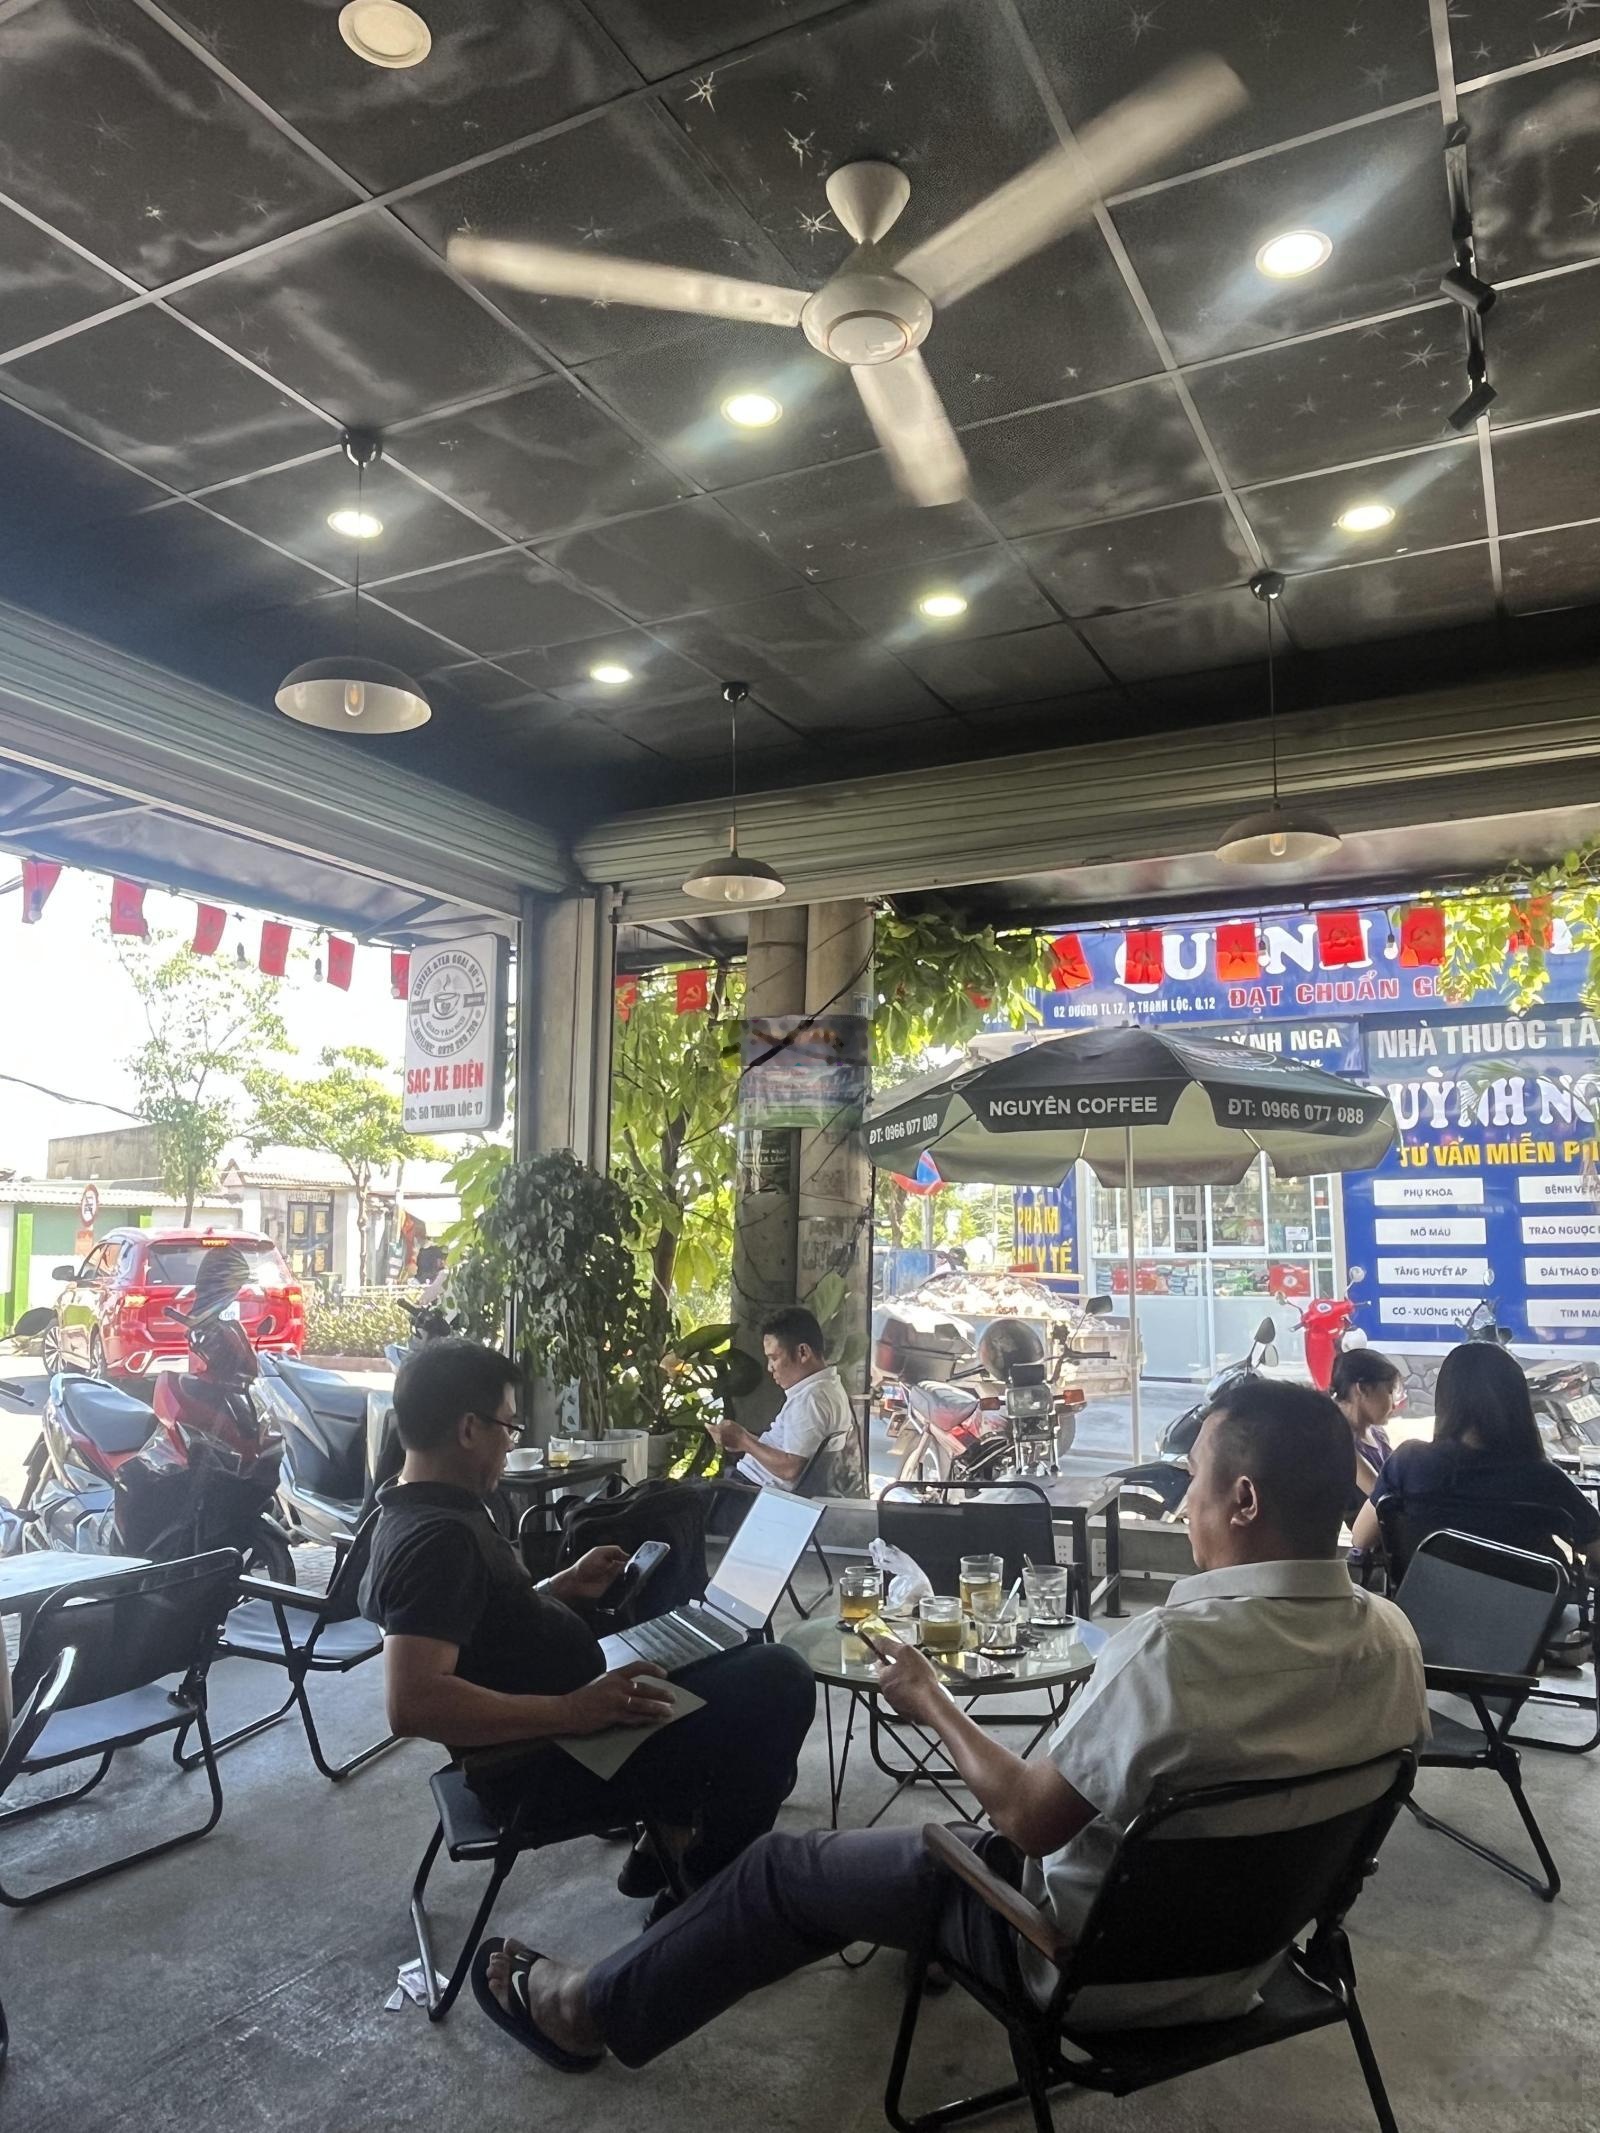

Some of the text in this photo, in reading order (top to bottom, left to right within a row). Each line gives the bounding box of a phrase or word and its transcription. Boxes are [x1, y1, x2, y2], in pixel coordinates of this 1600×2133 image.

[1228, 984, 1283, 1014] ĐẠT
[1295, 970, 1400, 1004] CHUẨN
[1101, 1003, 1111, 1015] TL
[1290, 1028, 1343, 1050] NGA
[1377, 1019, 1438, 1058] NHÀ
[1442, 1015, 1547, 1055] THUỐC
[407, 1059, 484, 1098] SẠC XE ĐIỆN
[475, 1101, 483, 1116] 17
[989, 1095, 1158, 1117] NGUYÊN COFFEE
[1228, 1099, 1364, 1125] ĐT: 0966 077 088
[870, 1128, 883, 1144] ĐT:
[885, 1122, 905, 1140] 0966
[906, 1118, 921, 1136] 077
[1396, 1142, 1429, 1168] TƯ
[1434, 1136, 1480, 1167] VẤN
[1487, 1132, 1554, 1165] MIỄN
[1404, 1187, 1453, 1199] PHỤ KHOA
[1050, 1238, 1073, 1273] TẾ
[1560, 1309, 1579, 1318] TIM
